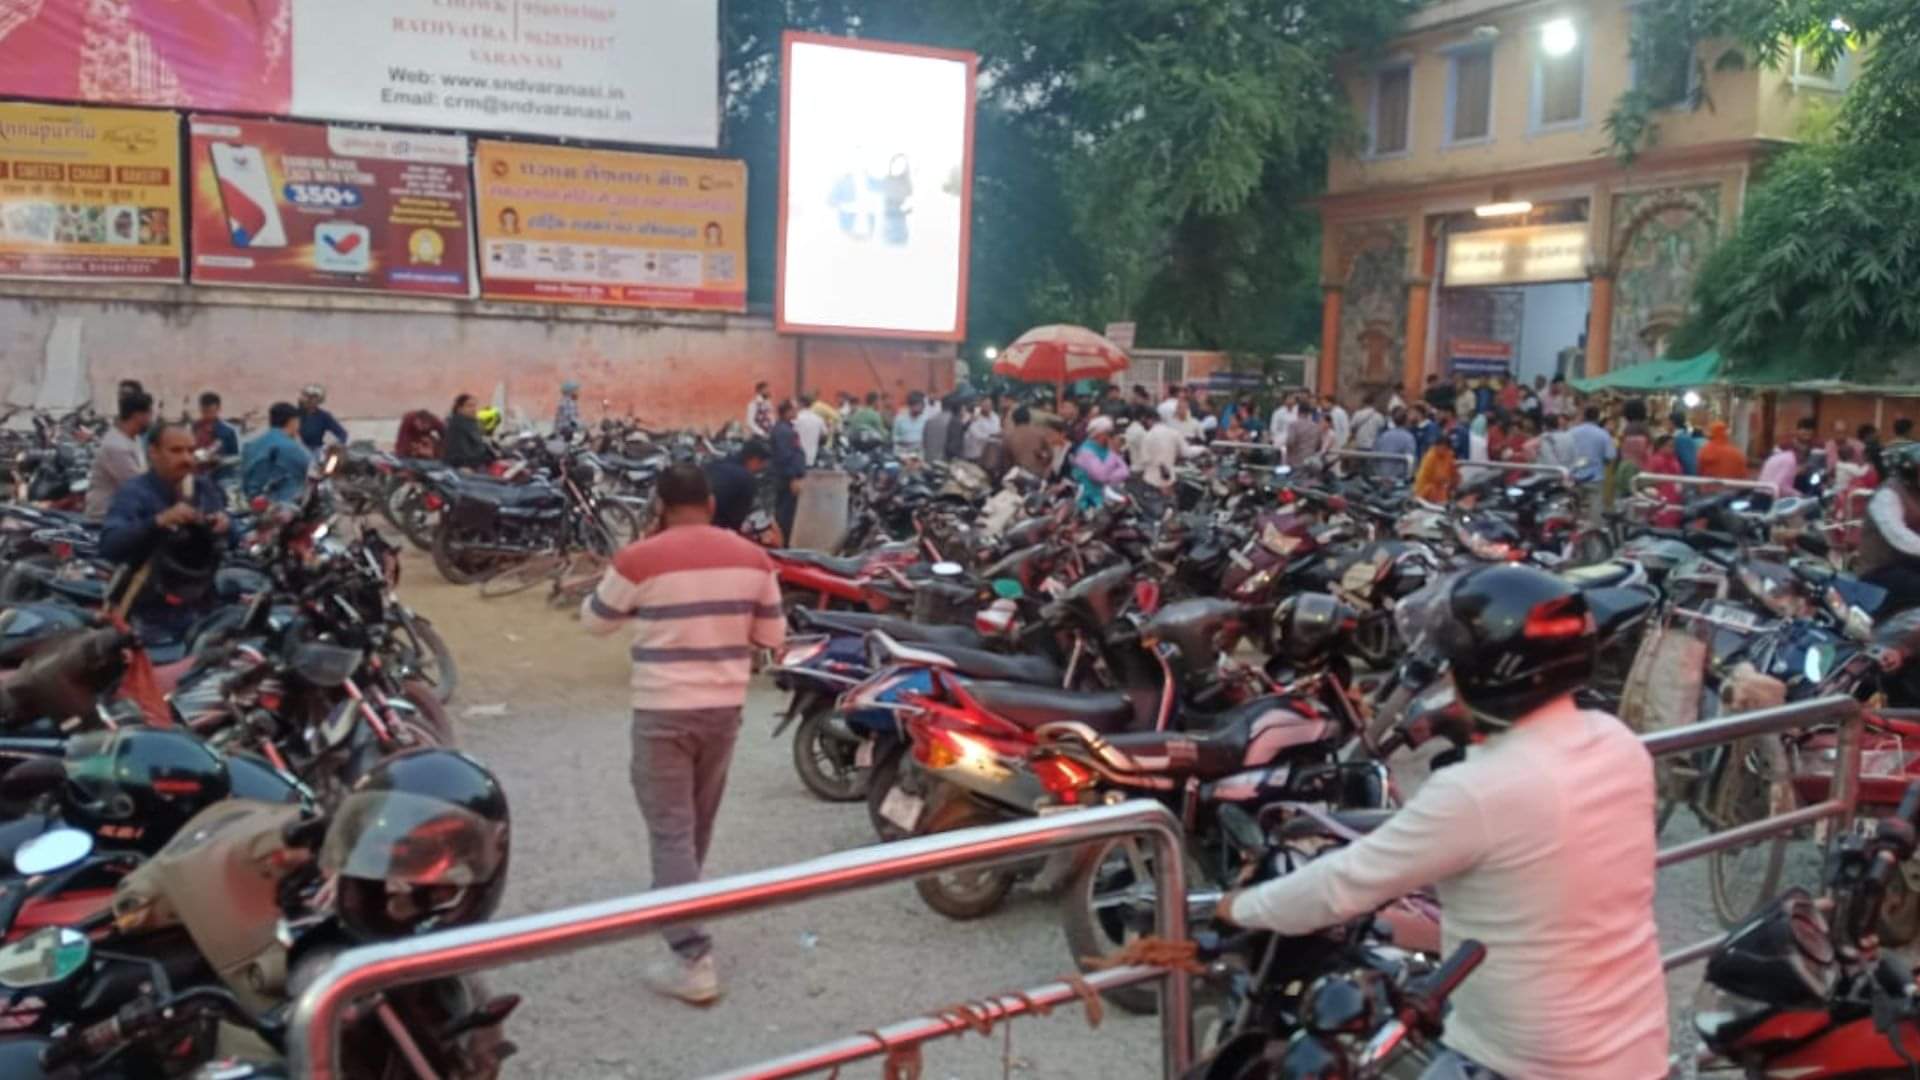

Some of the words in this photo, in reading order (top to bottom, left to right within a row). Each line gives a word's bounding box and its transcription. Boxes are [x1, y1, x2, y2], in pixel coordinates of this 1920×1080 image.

[392, 16, 506, 39] RATHYATRA
[470, 50, 563, 68] VARANASI
[387, 66, 433, 86] Web:
[440, 74, 624, 99] www.sndvaranasi.in
[379, 87, 436, 106] Email:
[443, 94, 632, 121] crm@sndvaranasi.in
[17, 164, 60, 178] SWEETS
[292, 184, 356, 204] 350+
